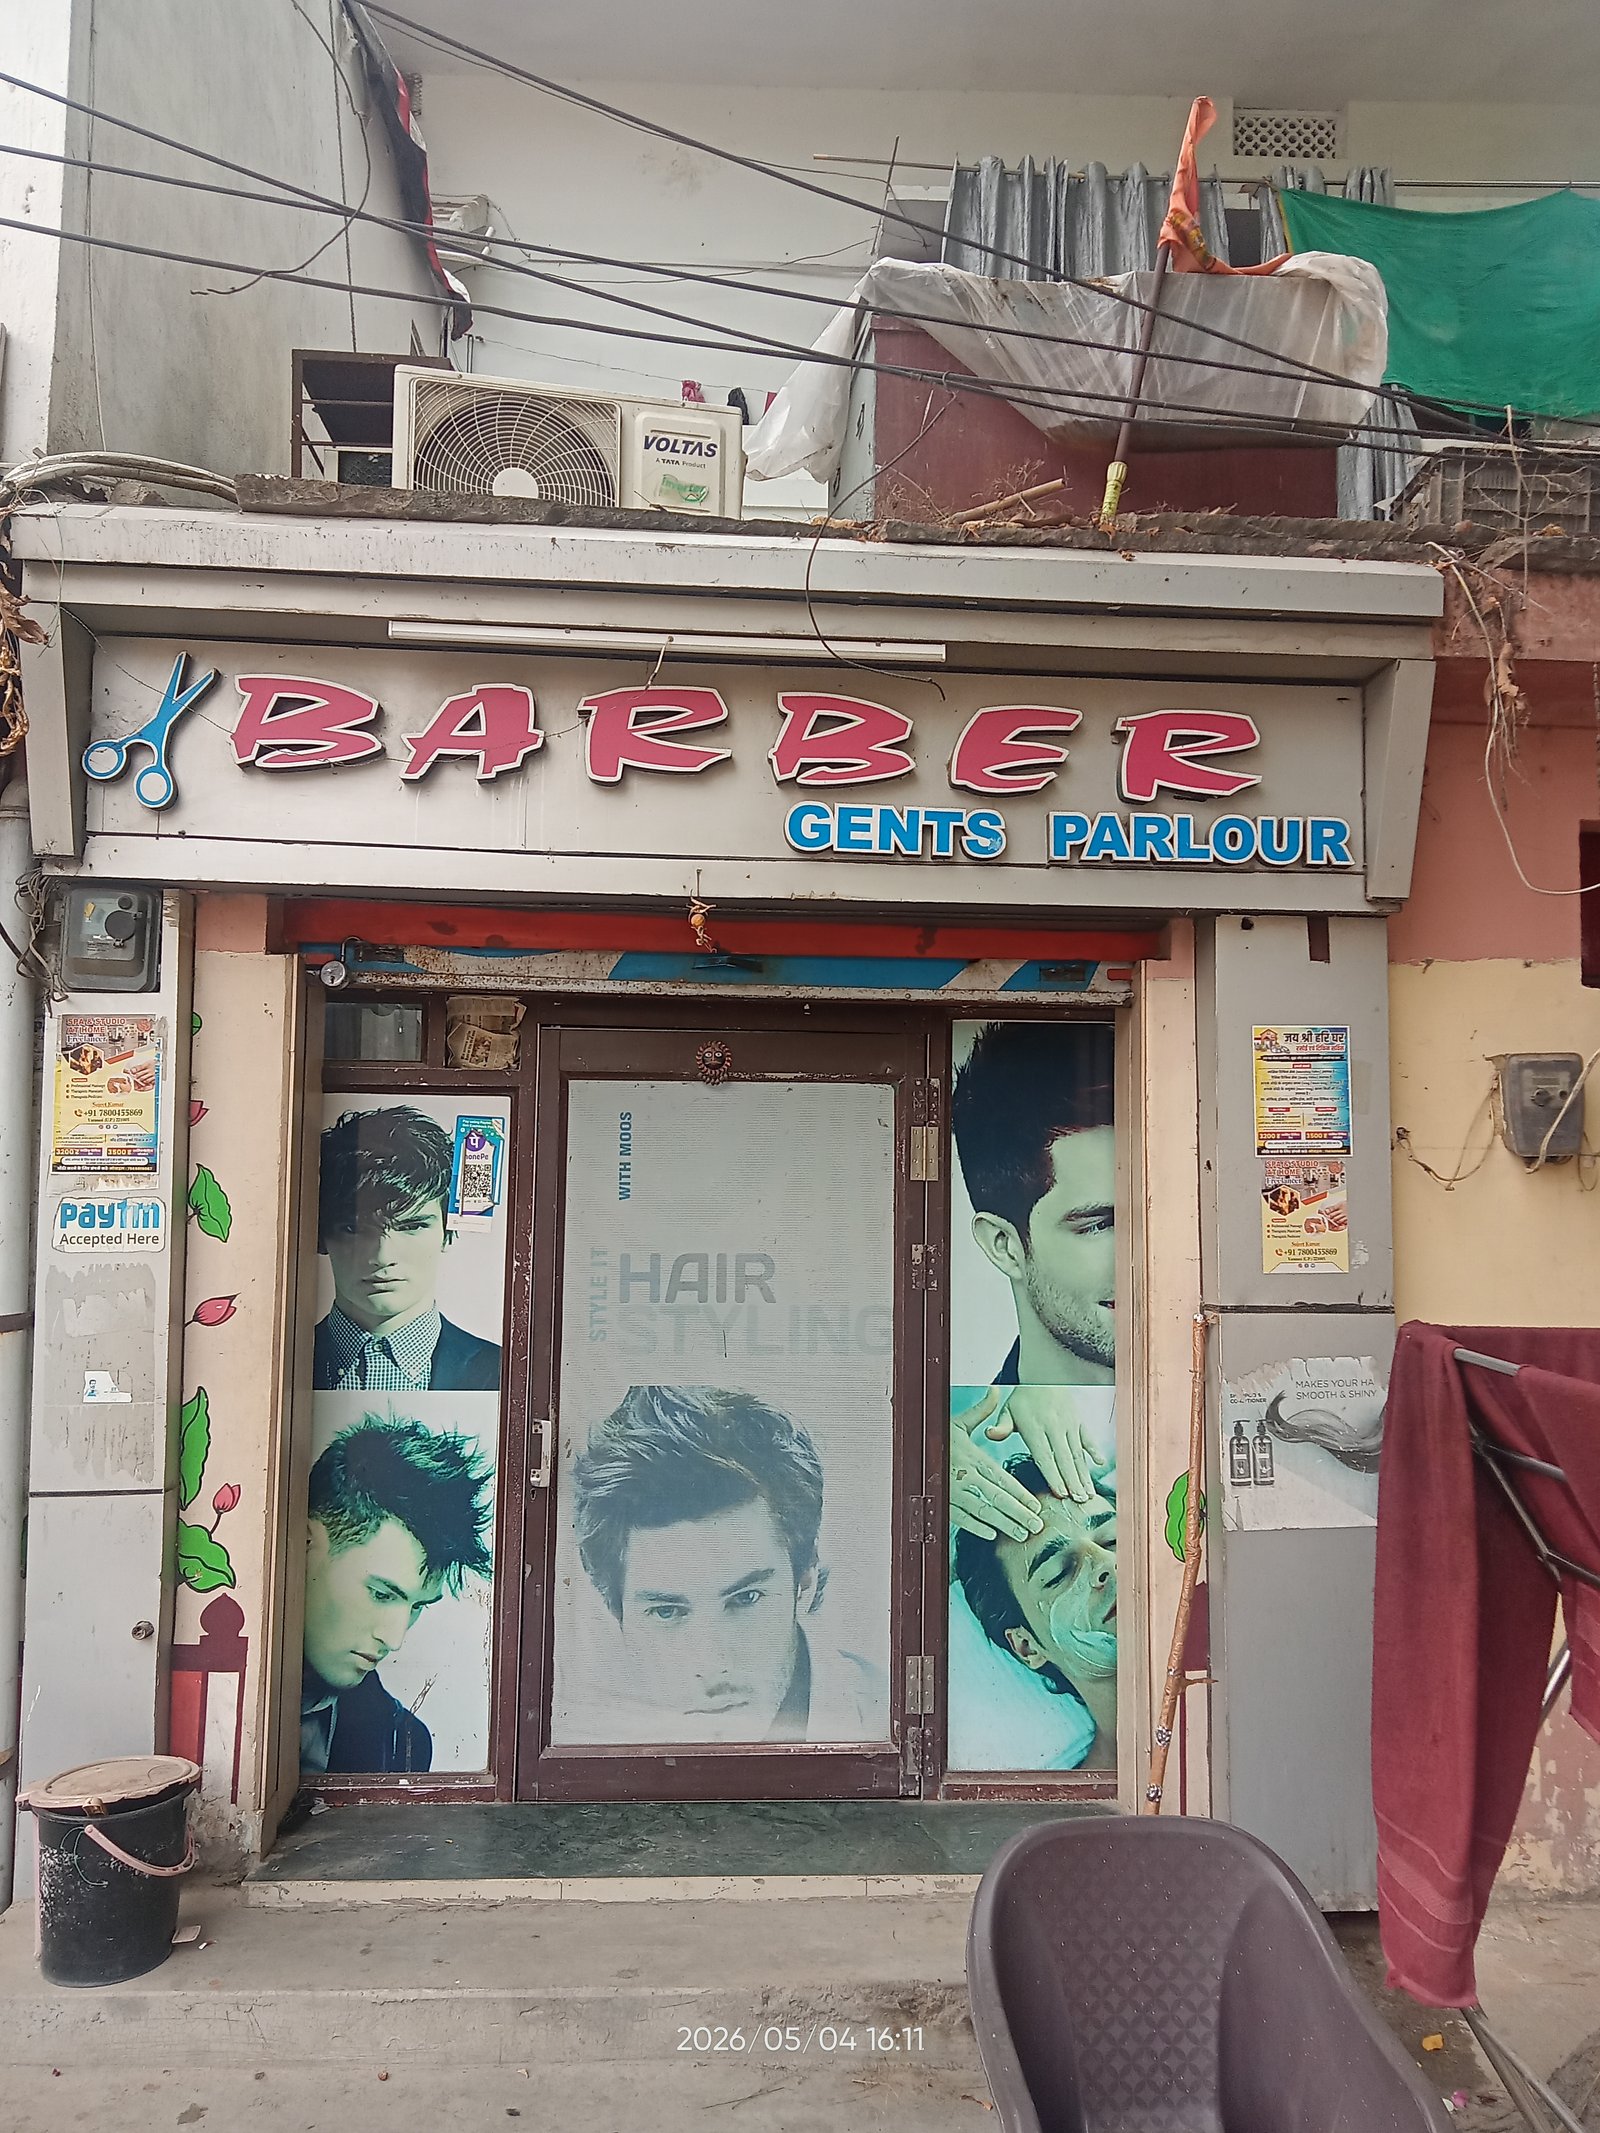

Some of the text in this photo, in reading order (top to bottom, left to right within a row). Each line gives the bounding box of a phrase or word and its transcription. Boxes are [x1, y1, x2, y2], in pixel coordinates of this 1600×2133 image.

[643, 435, 718, 458] VOLTAS
[682, 460, 706, 469] Product
[230, 672, 1263, 803] BARBER
[785, 801, 1355, 866] GENTS PARLOUR
[67, 1018, 85, 1026] SPA
[67, 1026, 105, 1034] AT HOME
[1283, 1030, 1345, 1043] जय श्री हरि घर
[84, 1109, 97, 1117] +91
[619, 1111, 632, 1201] WITH MOOS
[60, 1233, 159, 1247] Accepted Here
[618, 1252, 776, 1304] HAIR
[590, 1247, 608, 1341] STYLE IT
[1296, 1380, 1329, 1388] MAKES
[1331, 1379, 1358, 1387] YOUR
[1296, 1390, 1377, 1400] SMOOTH & SHINY
